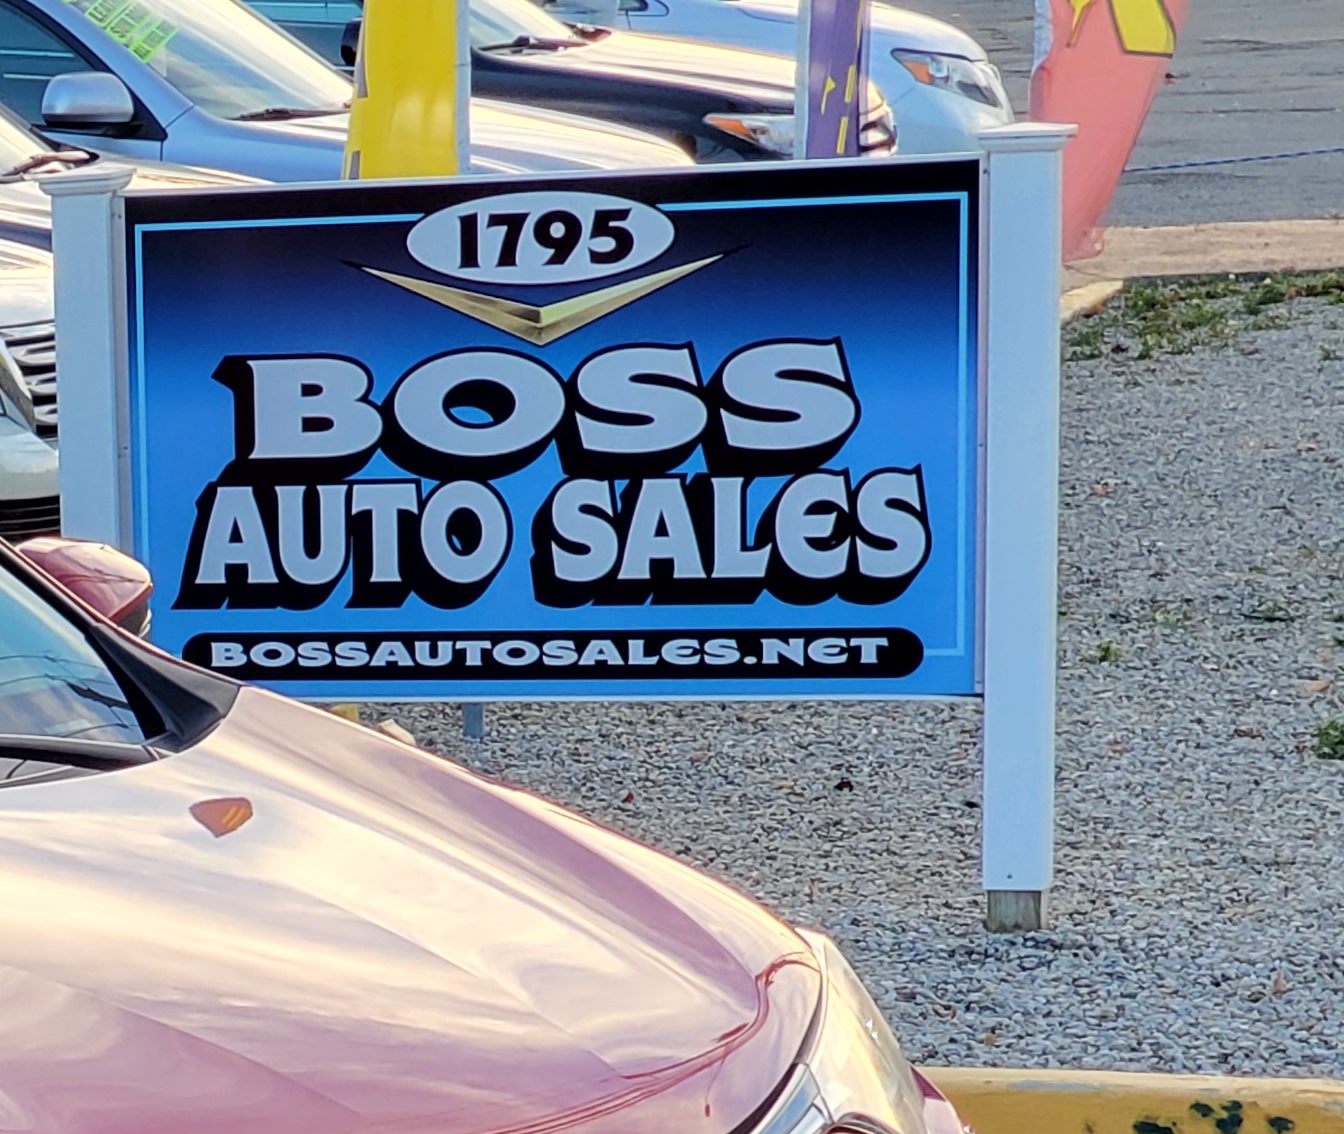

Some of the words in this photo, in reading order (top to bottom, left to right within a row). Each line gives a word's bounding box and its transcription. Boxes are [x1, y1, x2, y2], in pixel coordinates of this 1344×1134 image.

[456, 207, 636, 270] 1795
[246, 338, 859, 462] BOSS
[192, 478, 512, 586] AUTO
[550, 466, 931, 584] SALES
[210, 635, 890, 670] BOSSAUTOSALES.NET
